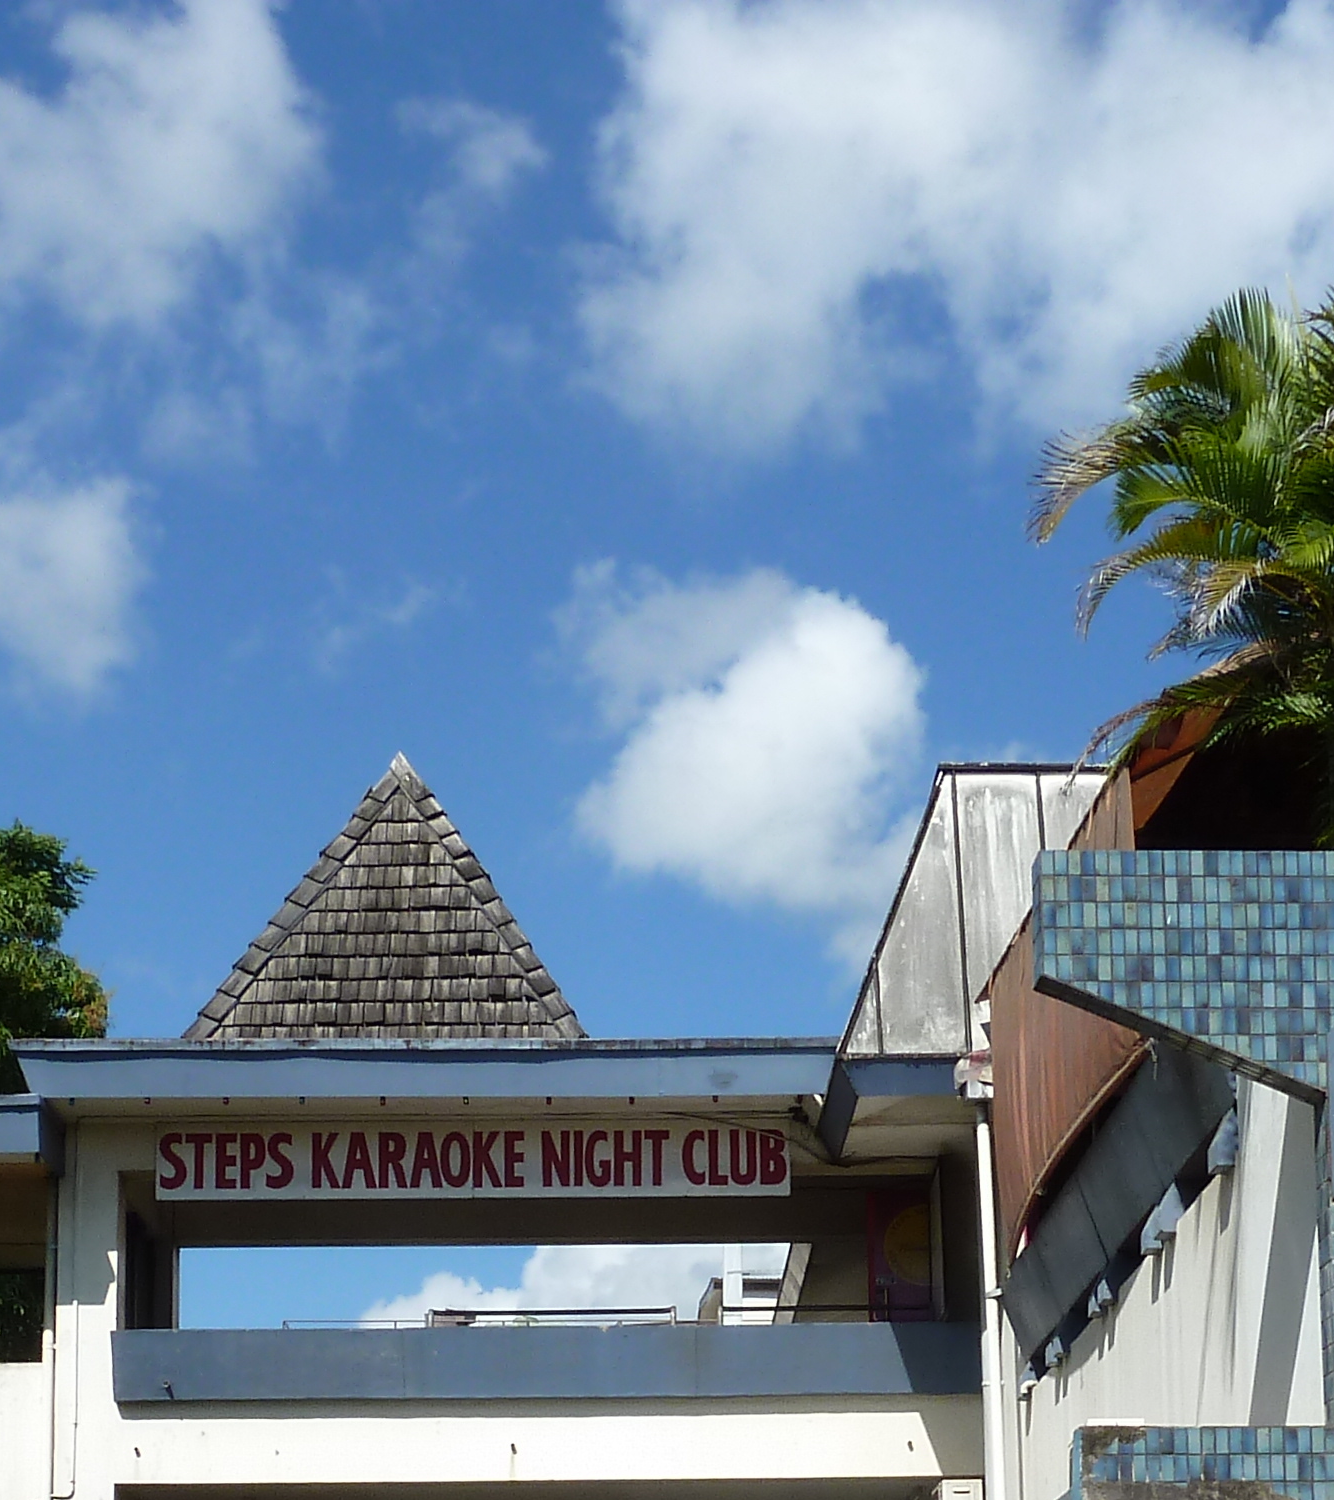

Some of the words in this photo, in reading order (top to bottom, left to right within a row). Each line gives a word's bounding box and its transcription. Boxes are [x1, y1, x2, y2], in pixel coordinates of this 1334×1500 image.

[159, 1131, 293, 1190] STEPS
[311, 1130, 524, 1189] KARAOKE
[542, 1129, 669, 1188] NIGHT
[681, 1129, 787, 1187] CLUB
